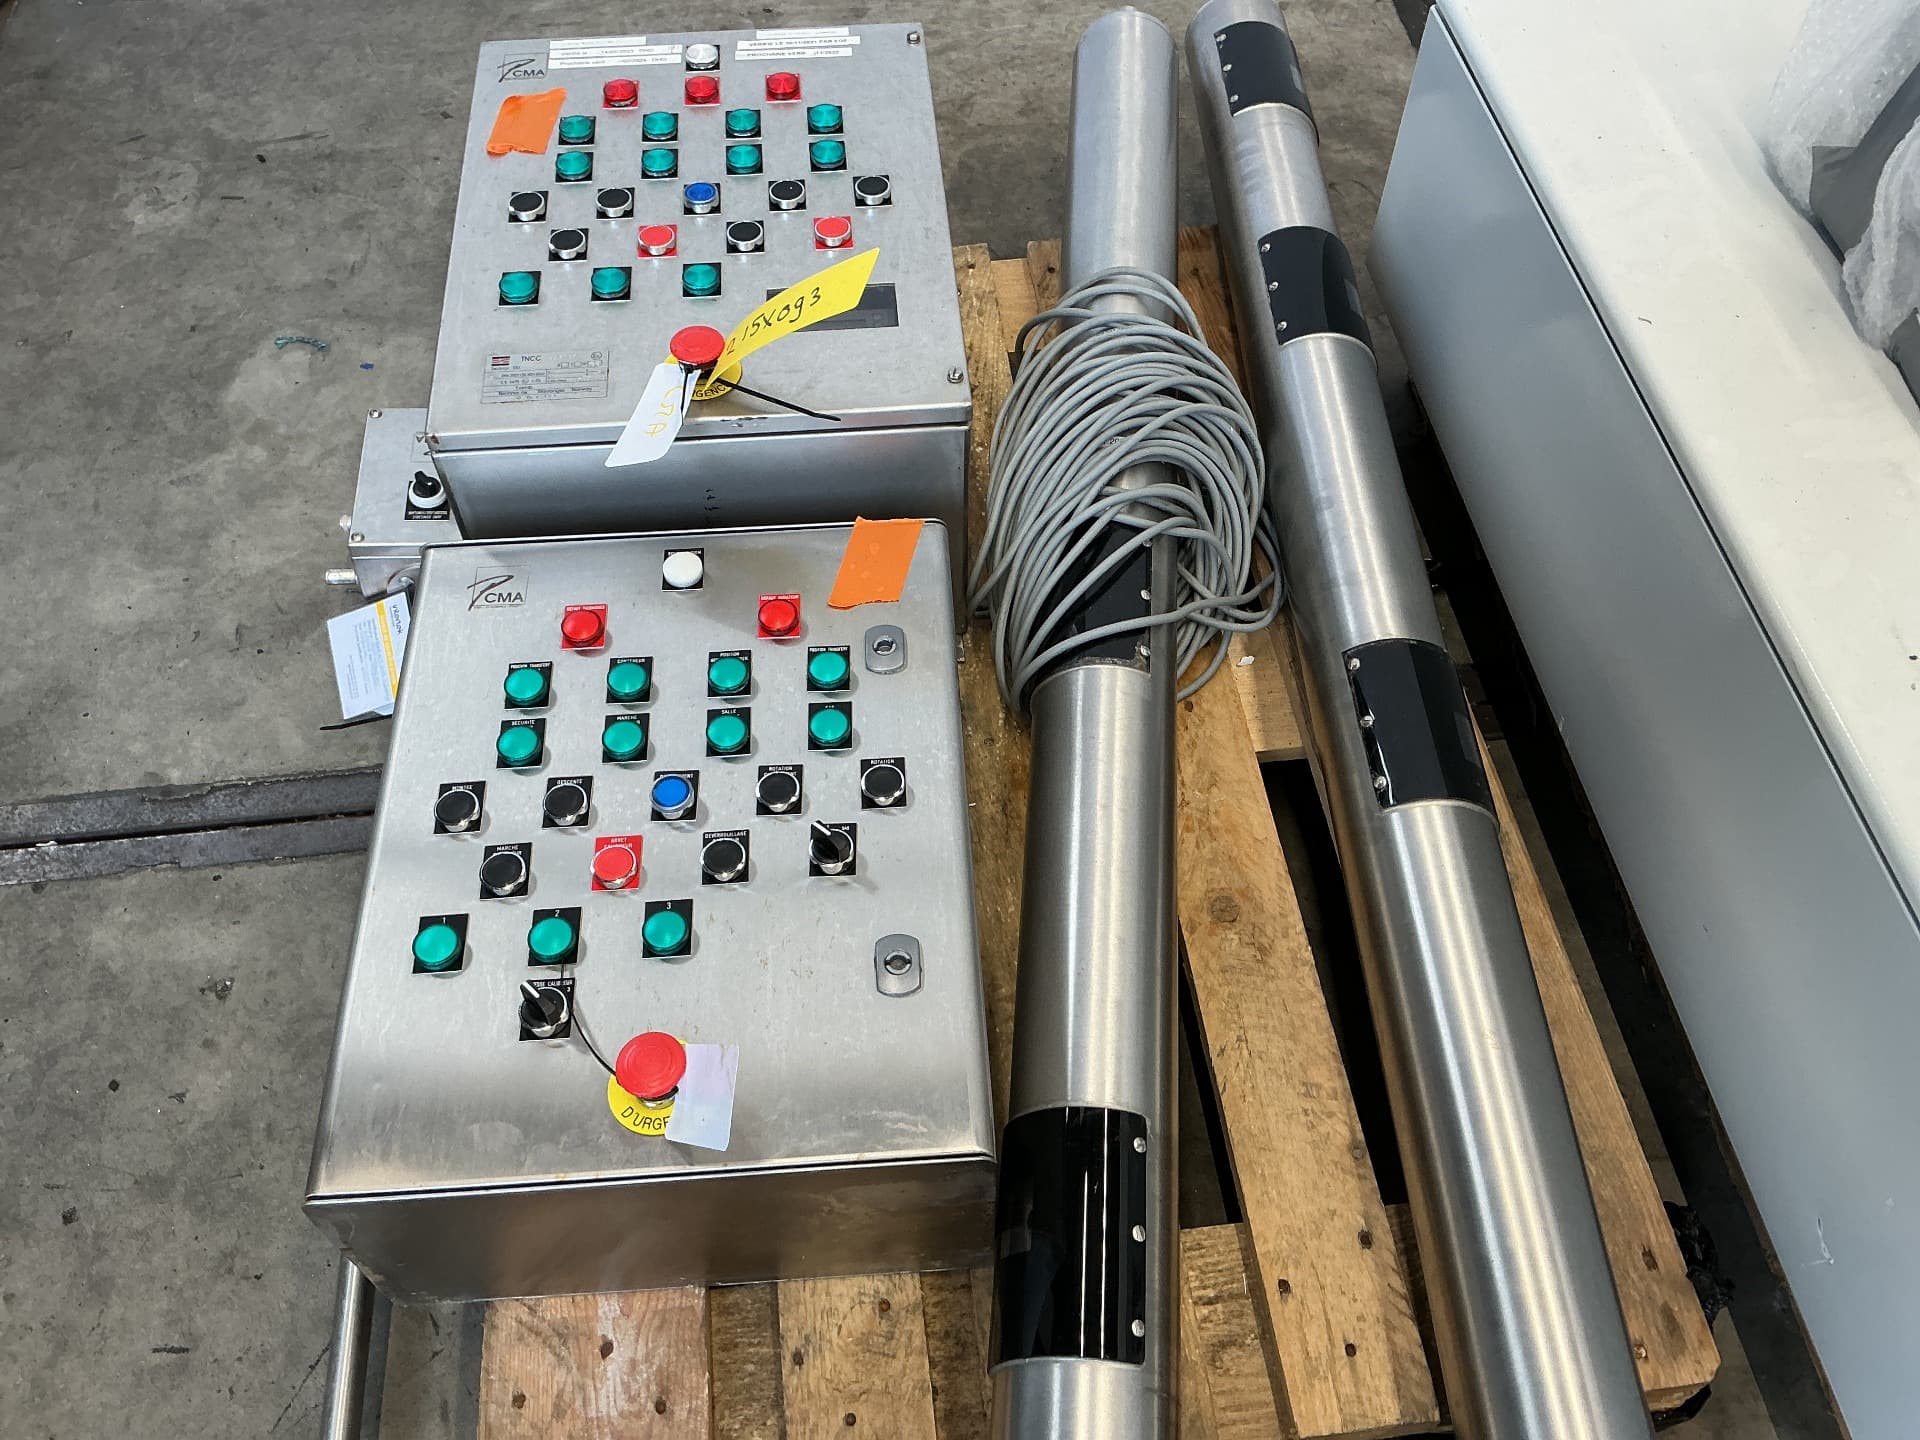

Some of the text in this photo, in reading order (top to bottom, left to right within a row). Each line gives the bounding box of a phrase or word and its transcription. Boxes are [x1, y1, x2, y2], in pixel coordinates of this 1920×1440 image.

[512, 68, 545, 78] CMA
[484, 591, 524, 603] CMA
[666, 902, 671, 910] 3
[554, 909, 560, 917] 2
